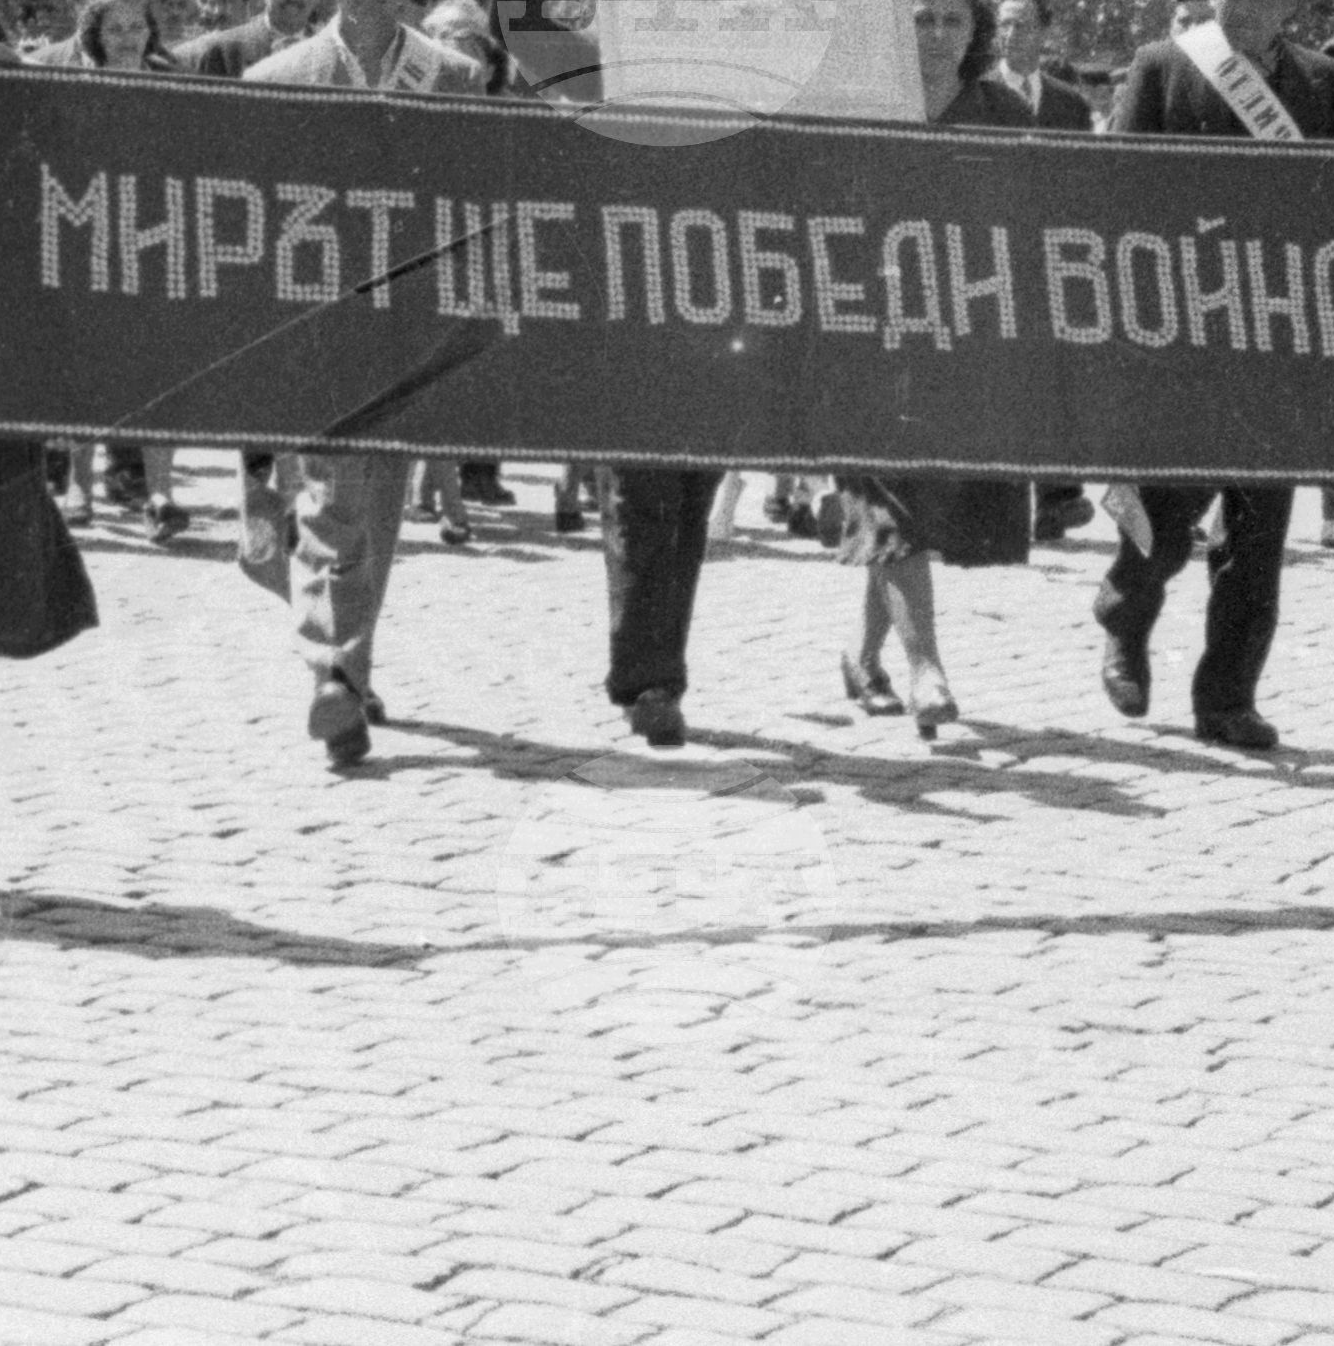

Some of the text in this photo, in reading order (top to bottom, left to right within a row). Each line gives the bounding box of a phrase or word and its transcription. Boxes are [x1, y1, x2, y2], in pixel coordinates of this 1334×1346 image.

[40, 163, 416, 308] МИРЪТ
[435, 197, 580, 335] ЩЕ
[601, 205, 1017, 350] ПОБЕДИ
